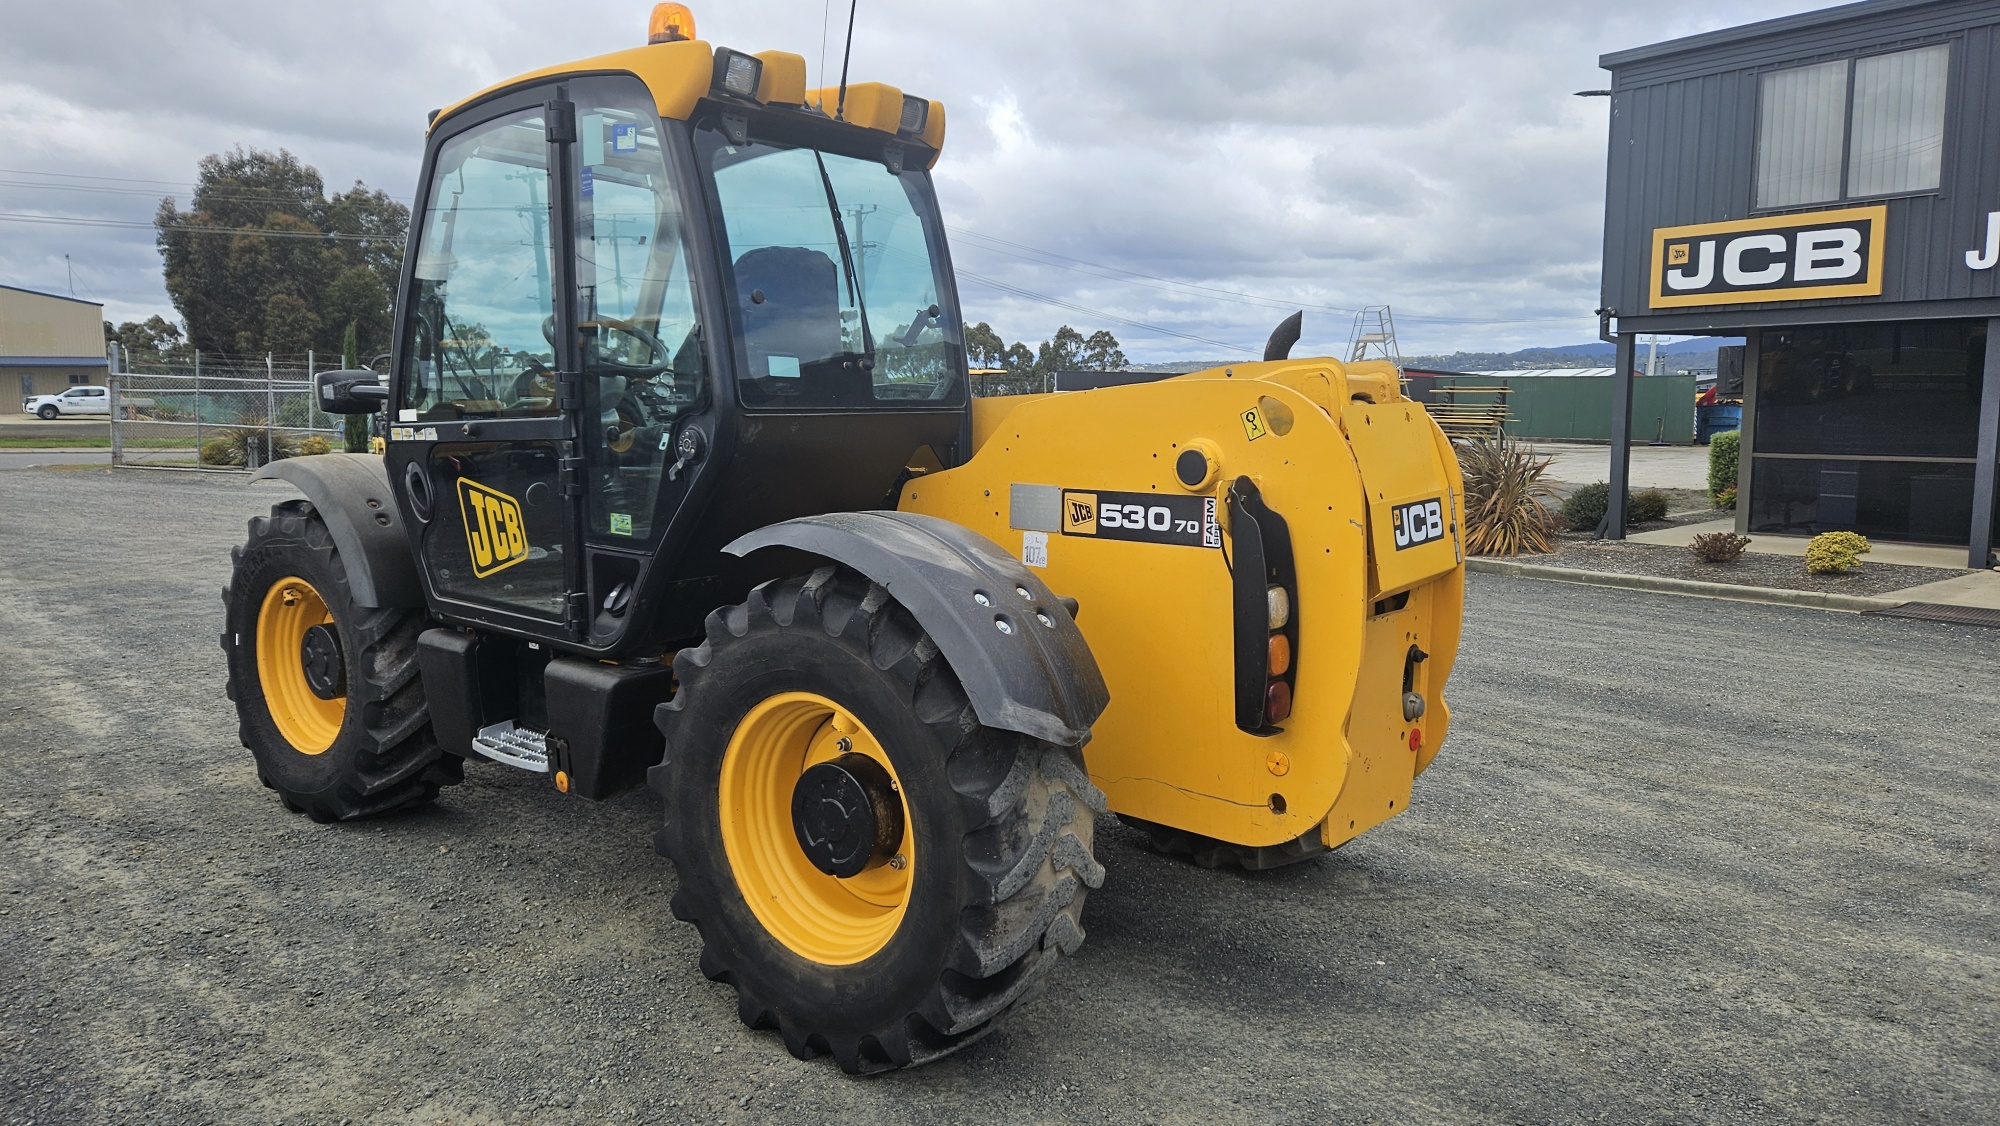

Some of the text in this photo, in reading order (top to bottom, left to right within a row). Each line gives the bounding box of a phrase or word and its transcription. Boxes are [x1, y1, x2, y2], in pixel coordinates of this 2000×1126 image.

[1667, 228, 1861, 290] JCB
[469, 489, 523, 567] JCB
[1071, 501, 1093, 523] JCB
[1100, 503, 1171, 531] 530
[1175, 520, 1199, 533] 70
[1205, 500, 1214, 545] FARM
[1395, 501, 1443, 546] JCB
[1025, 546, 1041, 564] 107
